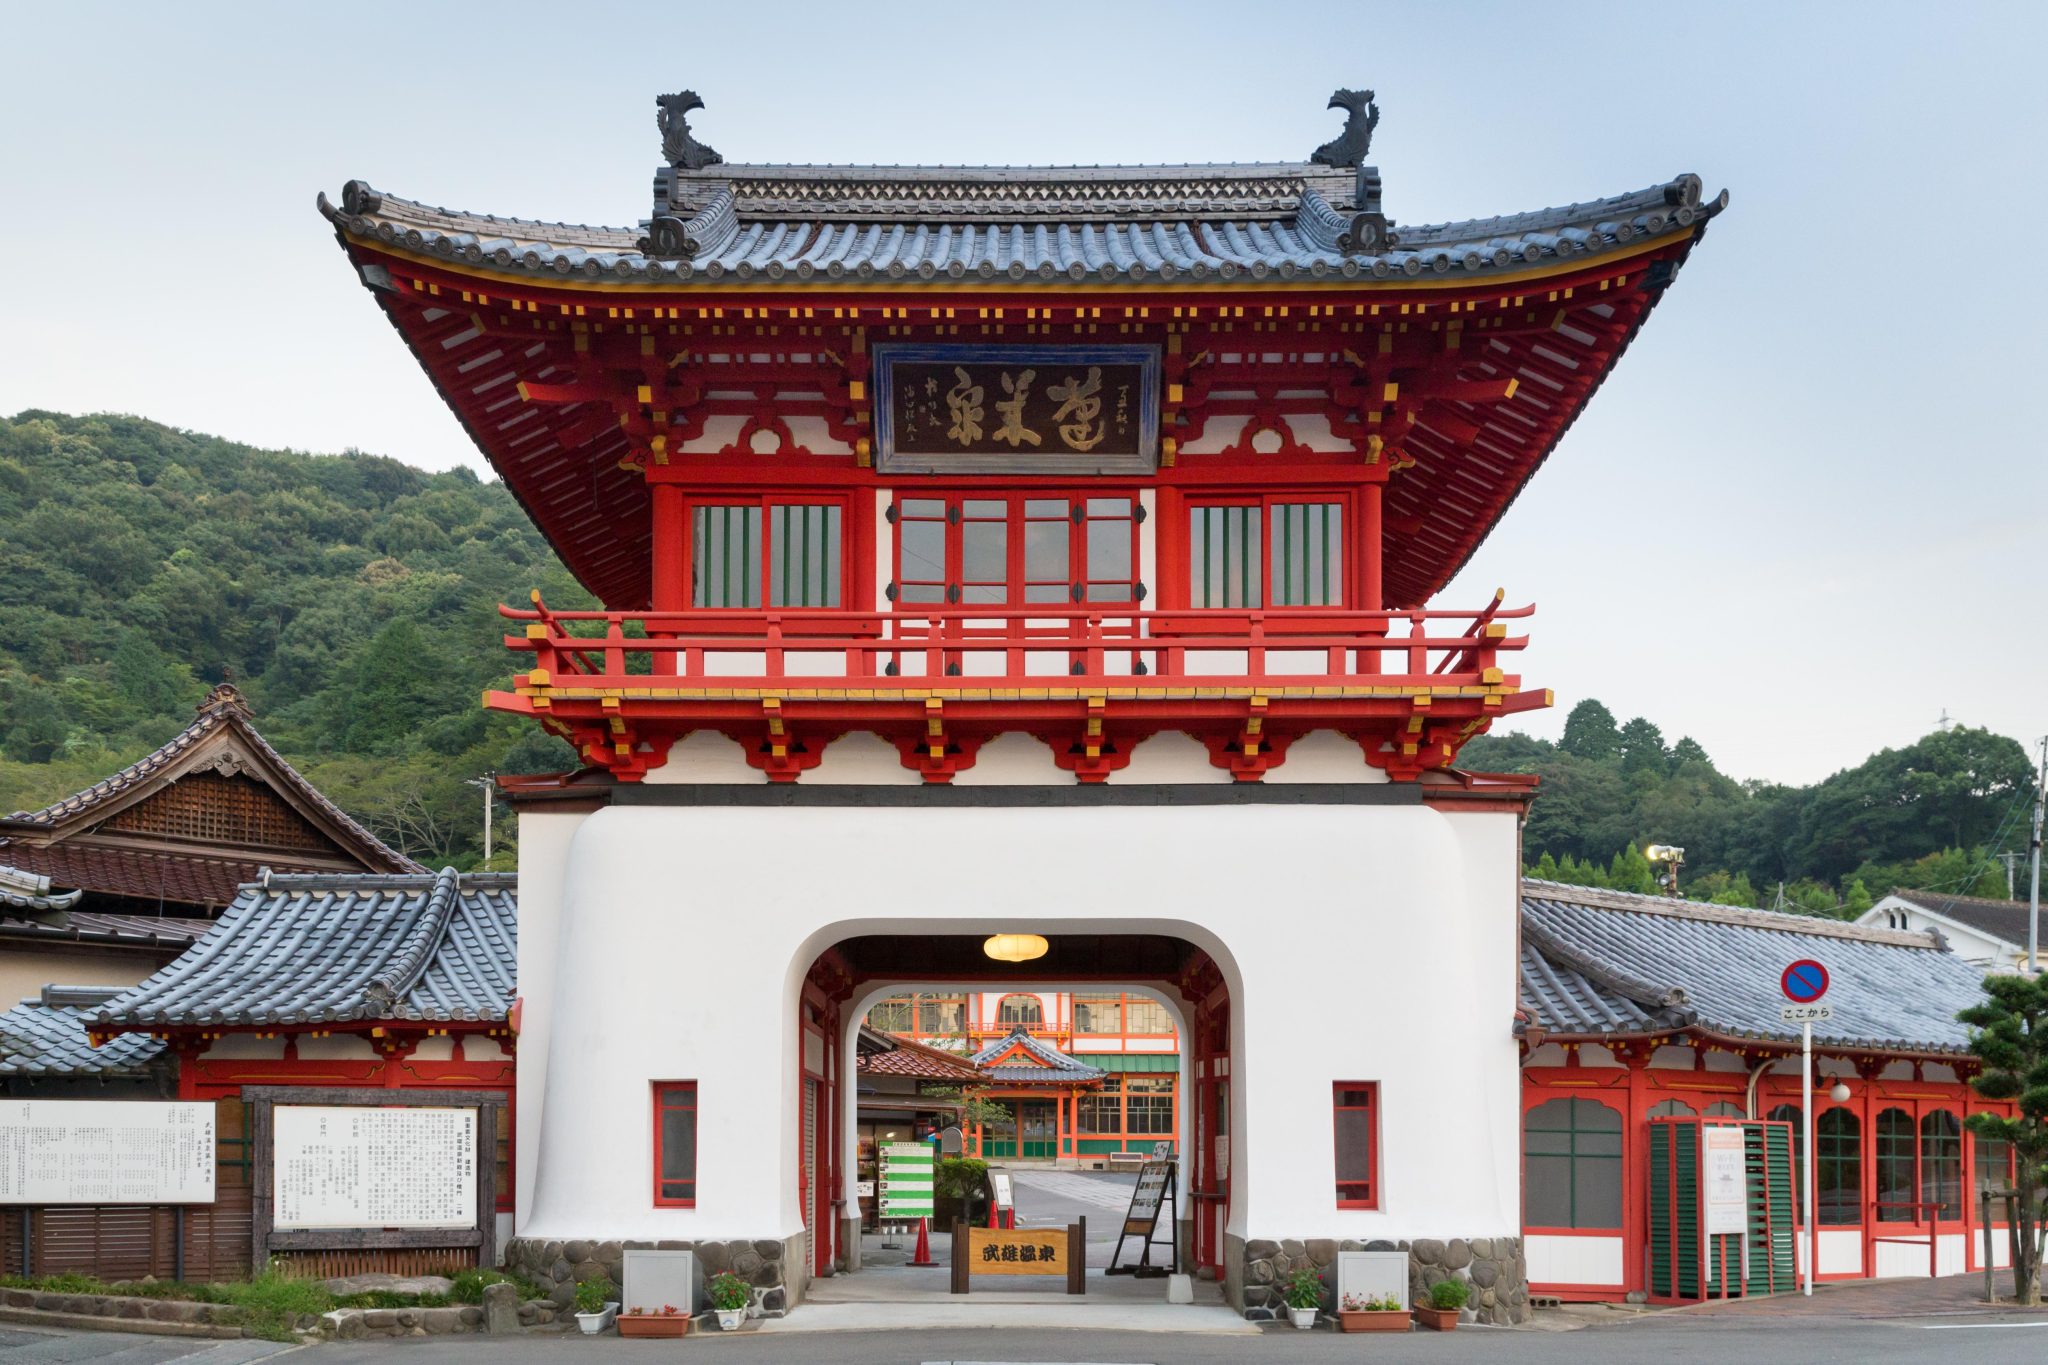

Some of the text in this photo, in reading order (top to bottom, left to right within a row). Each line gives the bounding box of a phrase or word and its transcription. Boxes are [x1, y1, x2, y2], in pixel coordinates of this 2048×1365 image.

[1784, 1007, 1829, 1019] ここから
[982, 1243, 1056, 1263] 武雄温泉
